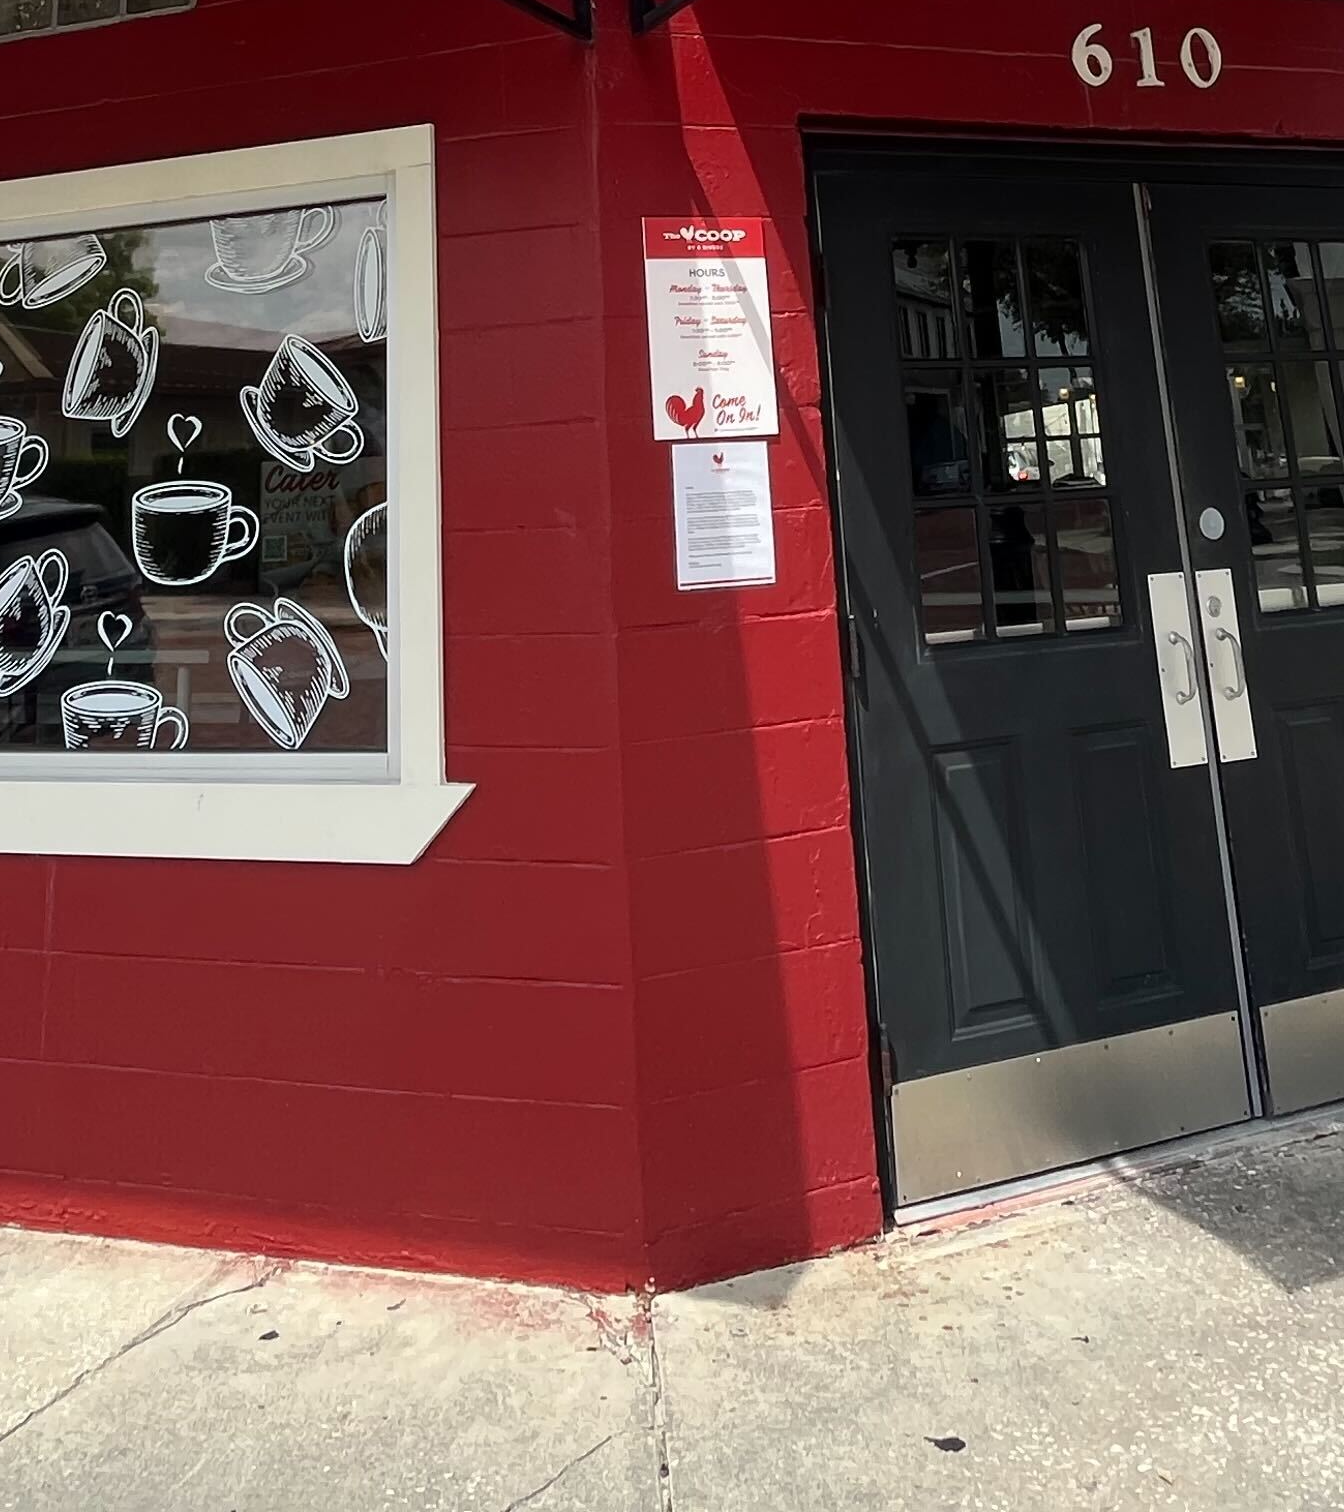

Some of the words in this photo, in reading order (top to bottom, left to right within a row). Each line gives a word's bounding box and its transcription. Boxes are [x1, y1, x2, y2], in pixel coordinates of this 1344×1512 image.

[1071, 23, 1222, 89] 610
[694, 228, 747, 243] COOP
[688, 268, 726, 278] HOURS
[669, 284, 702, 294] Monday
[711, 282, 748, 294] Thursday
[674, 316, 702, 327] Friday
[698, 349, 729, 360] Sunday
[712, 393, 747, 410] Come
[716, 409, 736, 426] On
[738, 404, 762, 424] In!
[265, 465, 340, 494] Cater
[264, 495, 299, 509] YOUR
[303, 494, 336, 506] NEXT
